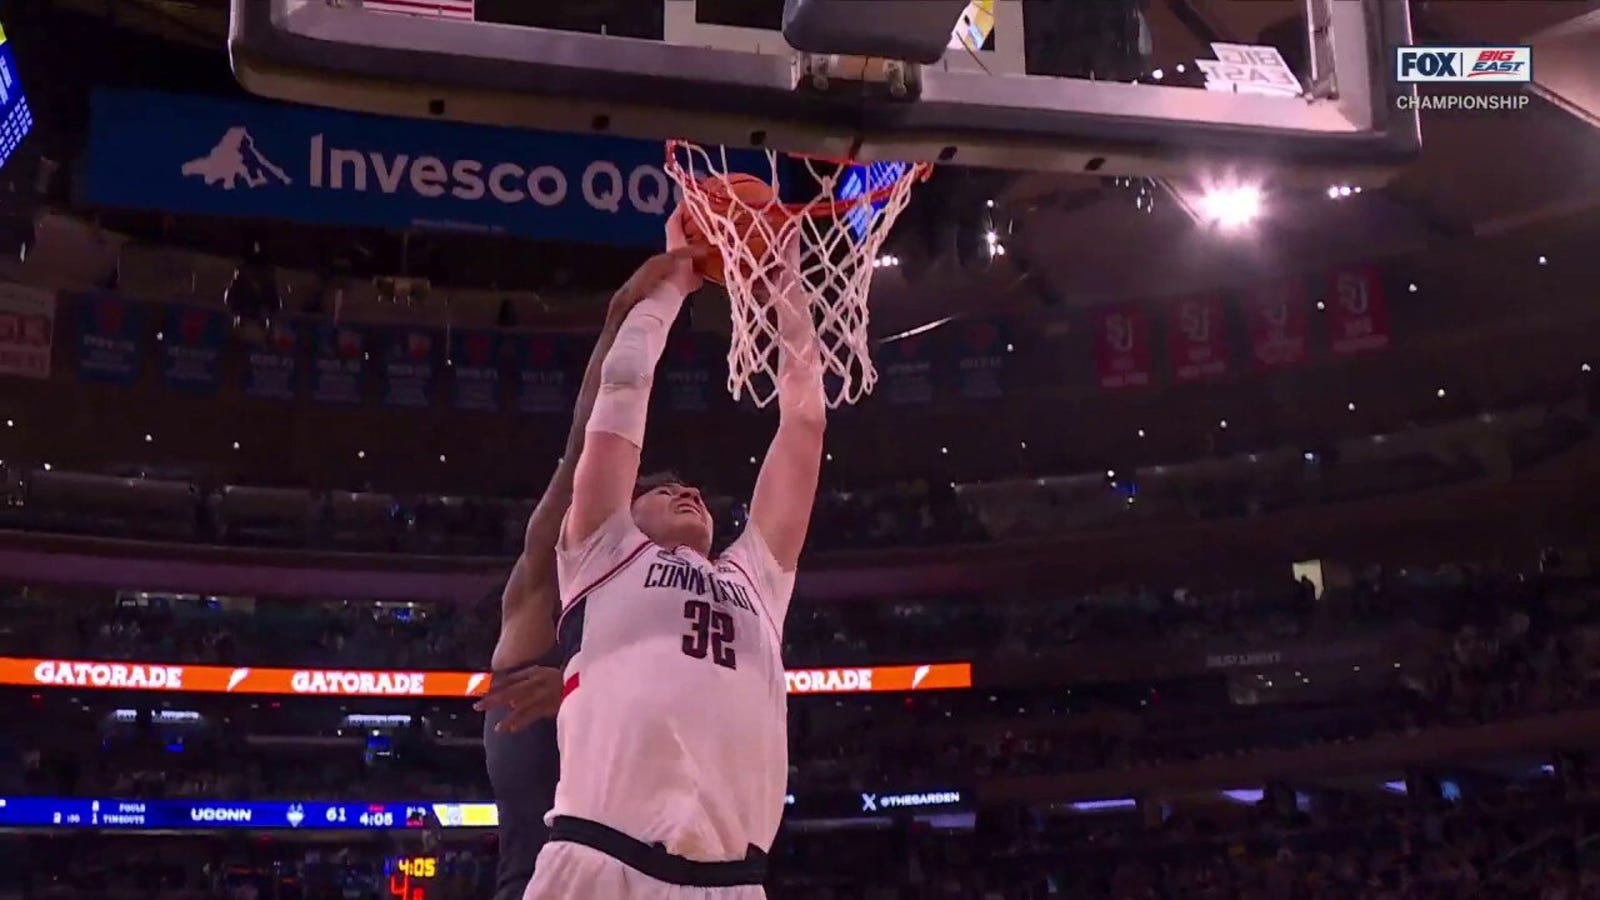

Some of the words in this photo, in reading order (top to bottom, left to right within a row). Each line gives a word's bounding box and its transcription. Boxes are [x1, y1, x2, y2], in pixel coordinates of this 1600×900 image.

[309, 132, 568, 206] Invesco
[681, 599, 738, 671] 32
[33, 661, 184, 688] GATORADE
[290, 671, 425, 694] GATORADE
[784, 668, 873, 693] TORADE
[190, 806, 252, 822] UCONN
[398, 857, 436, 877] 4:05
